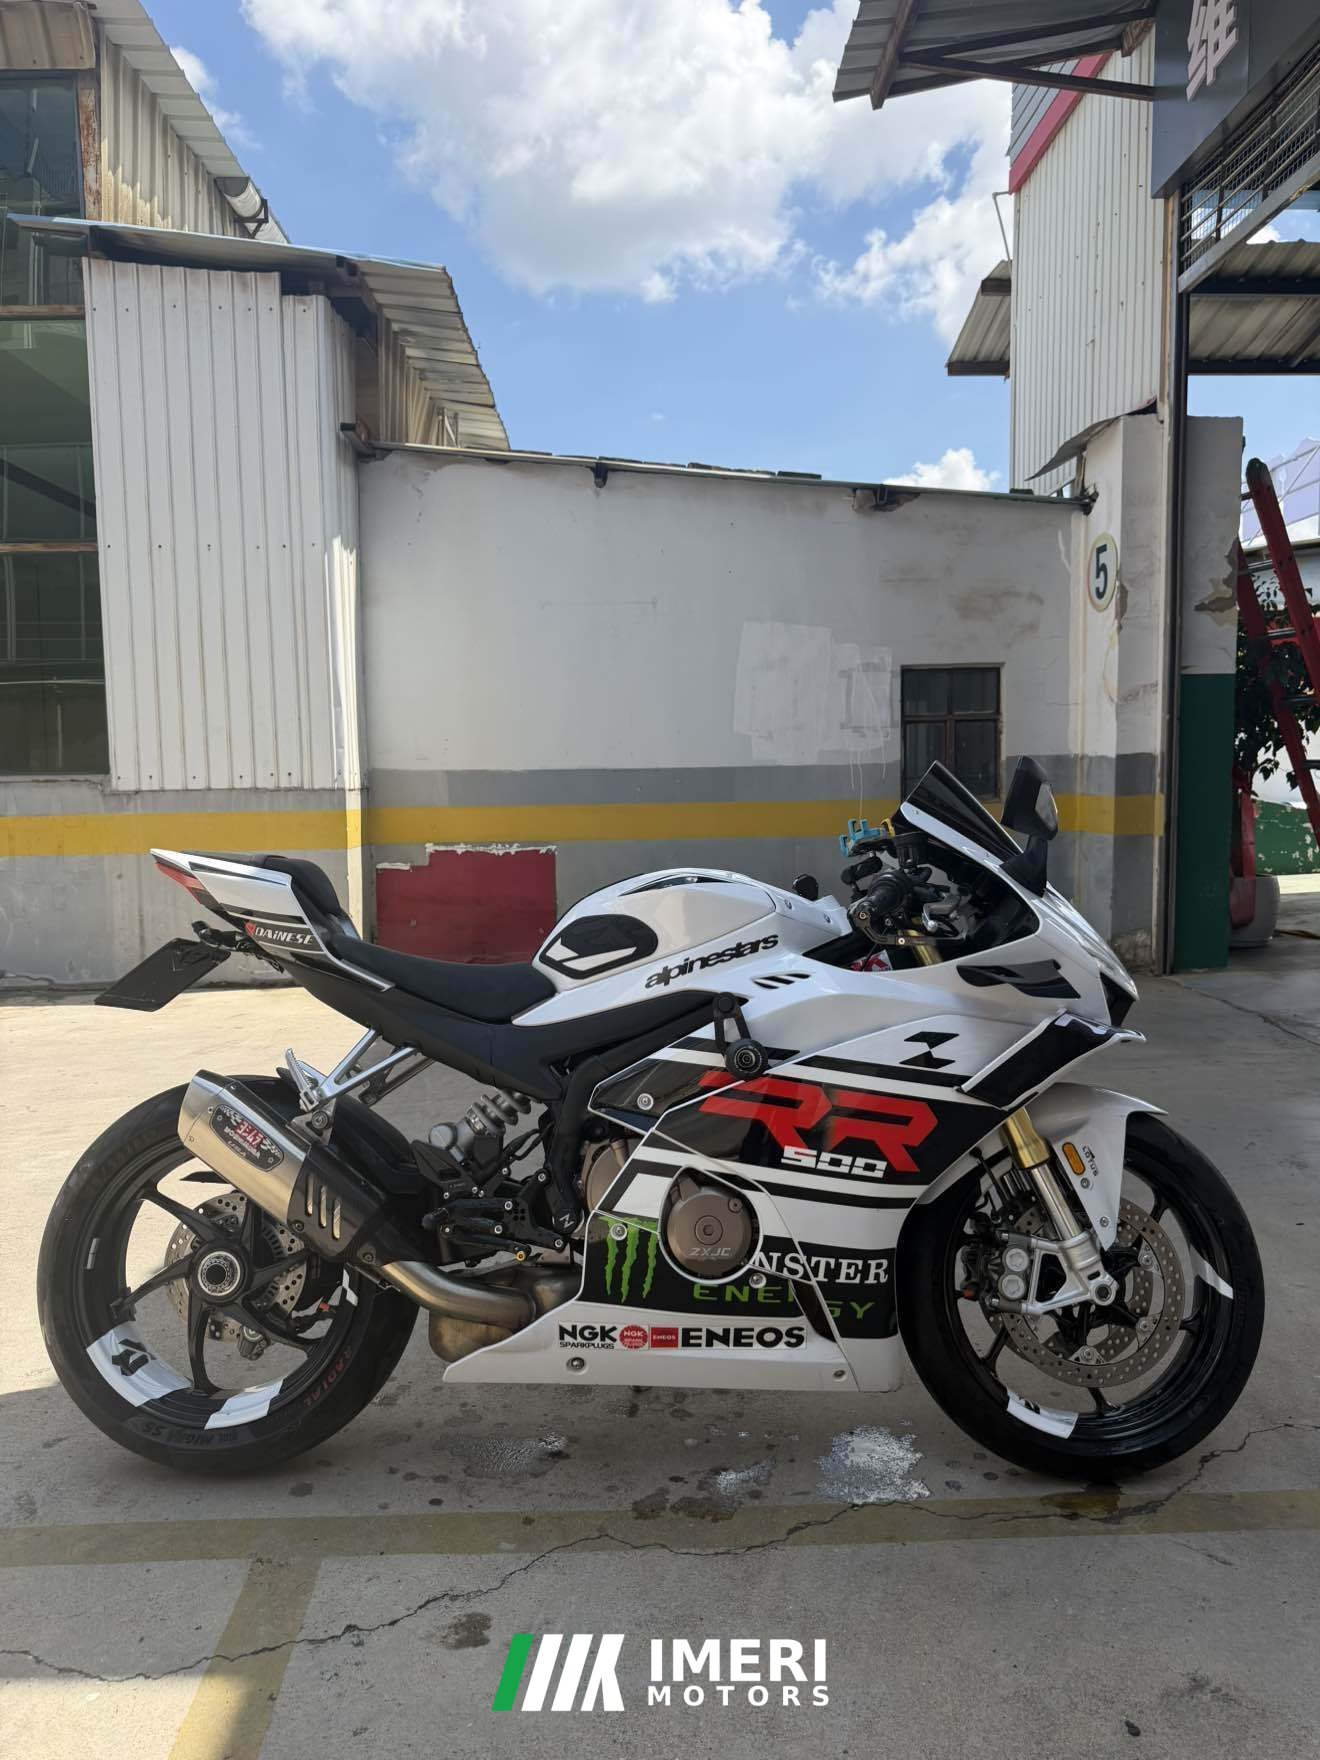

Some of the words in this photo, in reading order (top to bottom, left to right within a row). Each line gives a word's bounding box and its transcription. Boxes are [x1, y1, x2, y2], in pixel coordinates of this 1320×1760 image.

[1095, 543, 1108, 600] 5
[645, 934, 779, 989] alpinestars
[781, 1145, 887, 1178] 500
[752, 1251, 889, 1285] NSTER
[692, 1283, 875, 1320] ENEGY
[558, 1324, 617, 1342] NGK
[623, 1329, 643, 1338] NGK
[681, 1326, 805, 1348] ENEOS
